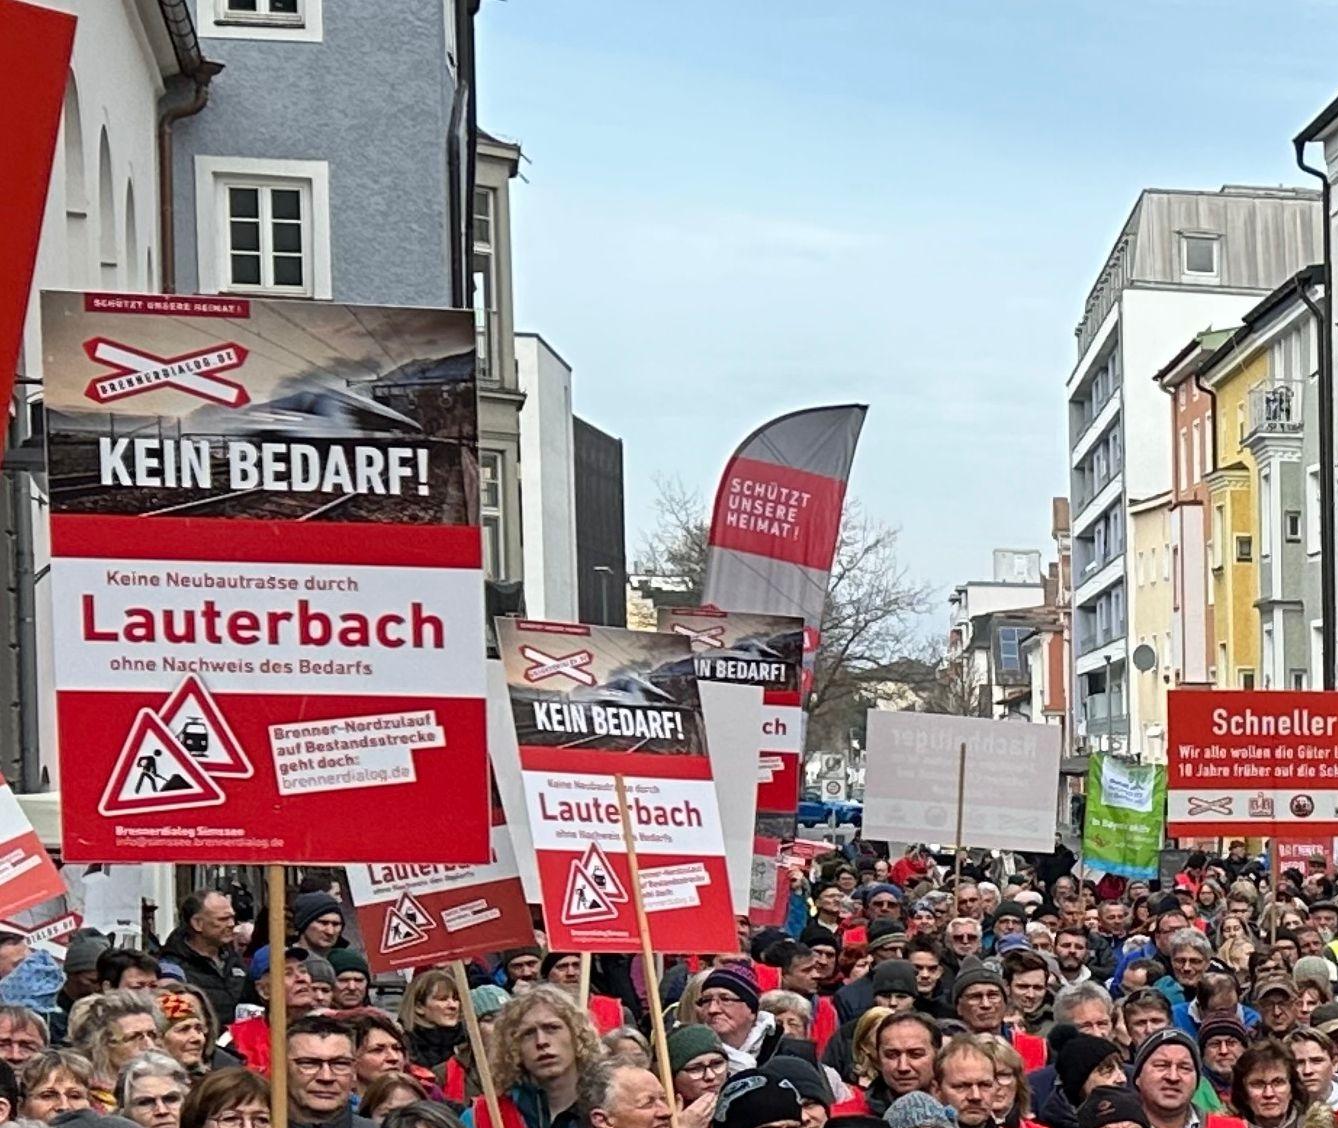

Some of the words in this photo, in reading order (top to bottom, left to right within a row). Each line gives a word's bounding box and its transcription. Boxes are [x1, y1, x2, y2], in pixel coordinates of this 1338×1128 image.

[100, 437, 211, 489] KEIN
[229, 442, 429, 496] BEDARF!
[731, 478, 811, 508] SCHÜTZT
[729, 495, 797, 522] UNSERE
[107, 570, 159, 587] Keine
[166, 572, 298, 590] Neubautrasse
[304, 576, 359, 591] durch
[82, 595, 445, 649] Lauterbach
[110, 658, 157, 672] ohne
[163, 658, 254, 675] Nachweis
[260, 659, 293, 674] des
[299, 660, 373, 676] Bedarfs
[695, 659, 711, 678] IN
[715, 660, 786, 682] BEDARF!
[273, 713, 431, 740] Brenner-Nordzulauf
[533, 702, 586, 733] KEIN
[593, 706, 684, 740] BEDARF!
[1212, 708, 1338, 737] Schneller
[276, 741, 302, 756] auf
[304, 731, 435, 754] Bestandsstrecke
[1178, 745, 1200, 759] Wir
[1275, 745, 1293, 759] die
[279, 757, 315, 774] geht
[539, 793, 703, 828] Lautebach
